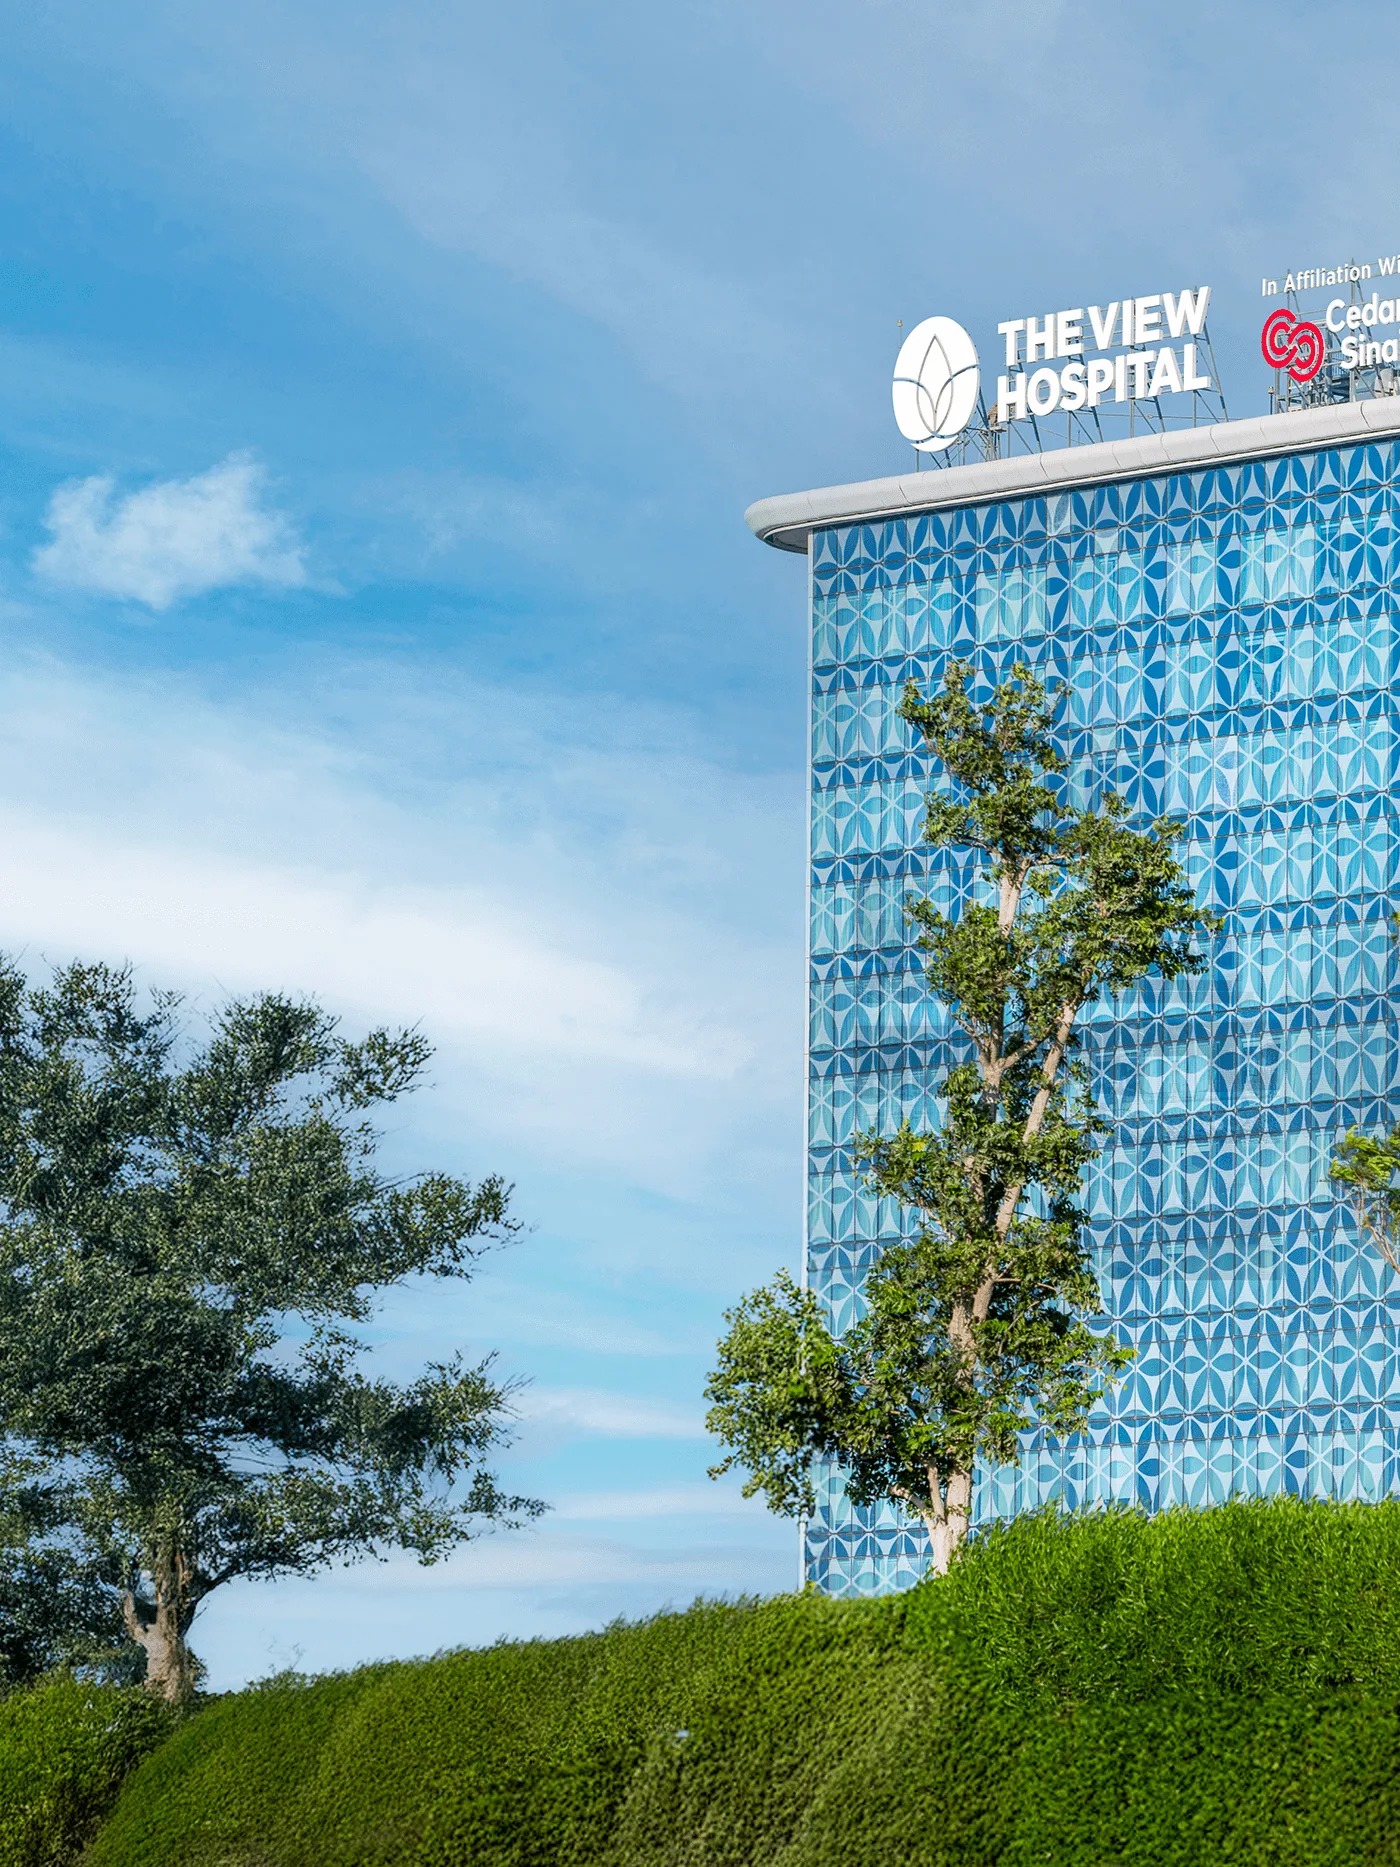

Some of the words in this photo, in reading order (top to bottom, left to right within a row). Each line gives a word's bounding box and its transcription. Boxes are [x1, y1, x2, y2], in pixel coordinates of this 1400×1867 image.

[1261, 278, 1278, 297] In
[1283, 262, 1372, 293] Affiliation
[998, 308, 1085, 367] THE
[1087, 286, 1212, 351] VIEW
[997, 343, 1212, 424] HOSPITAL
